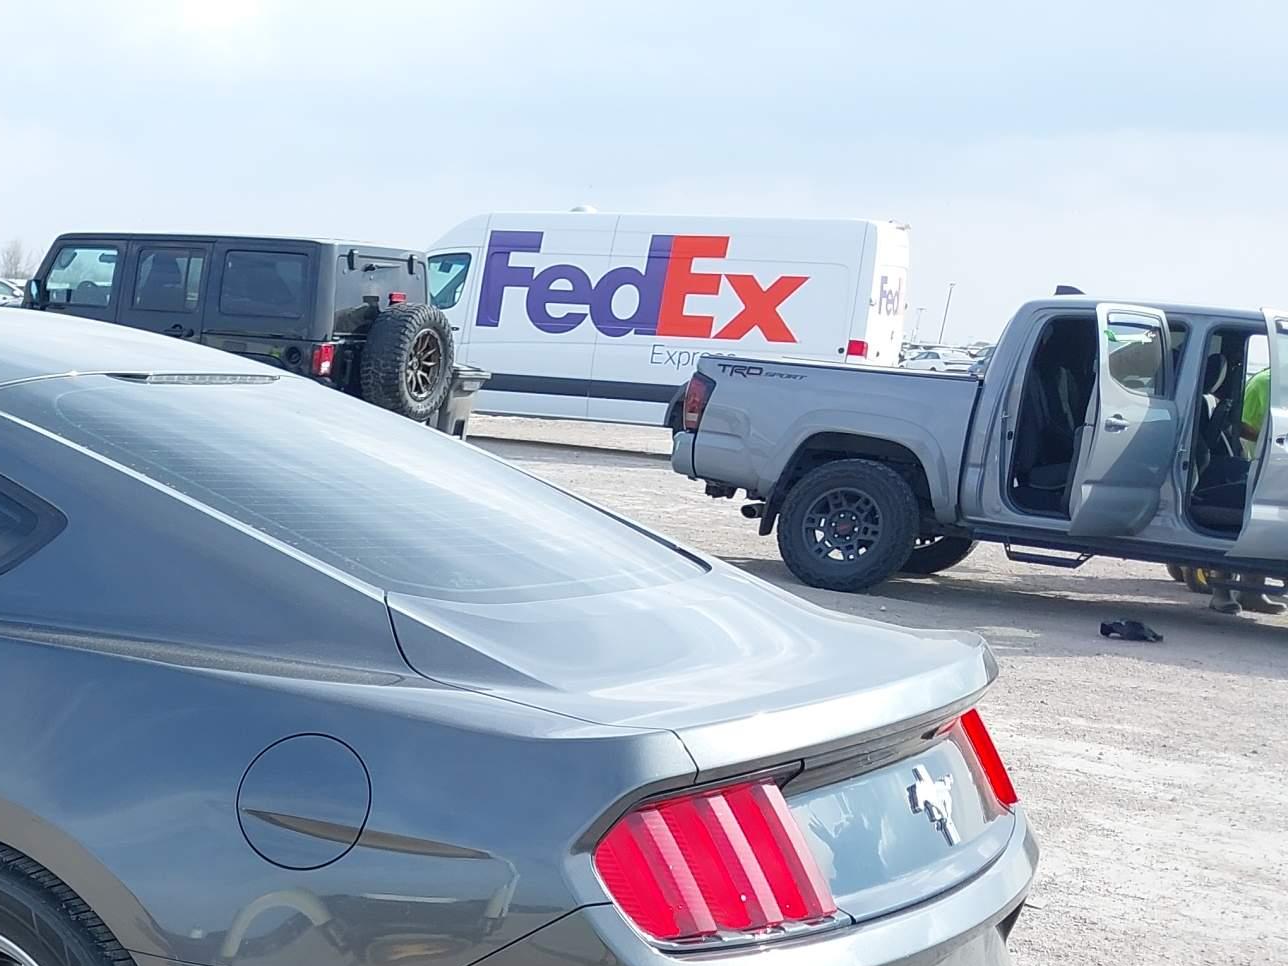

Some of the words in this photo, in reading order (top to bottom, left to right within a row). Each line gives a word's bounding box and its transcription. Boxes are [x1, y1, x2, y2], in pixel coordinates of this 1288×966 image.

[476, 229, 811, 344] FedEx
[650, 344, 736, 370] Expr
[717, 363, 764, 378] TRD
[763, 371, 808, 381] SPORT
